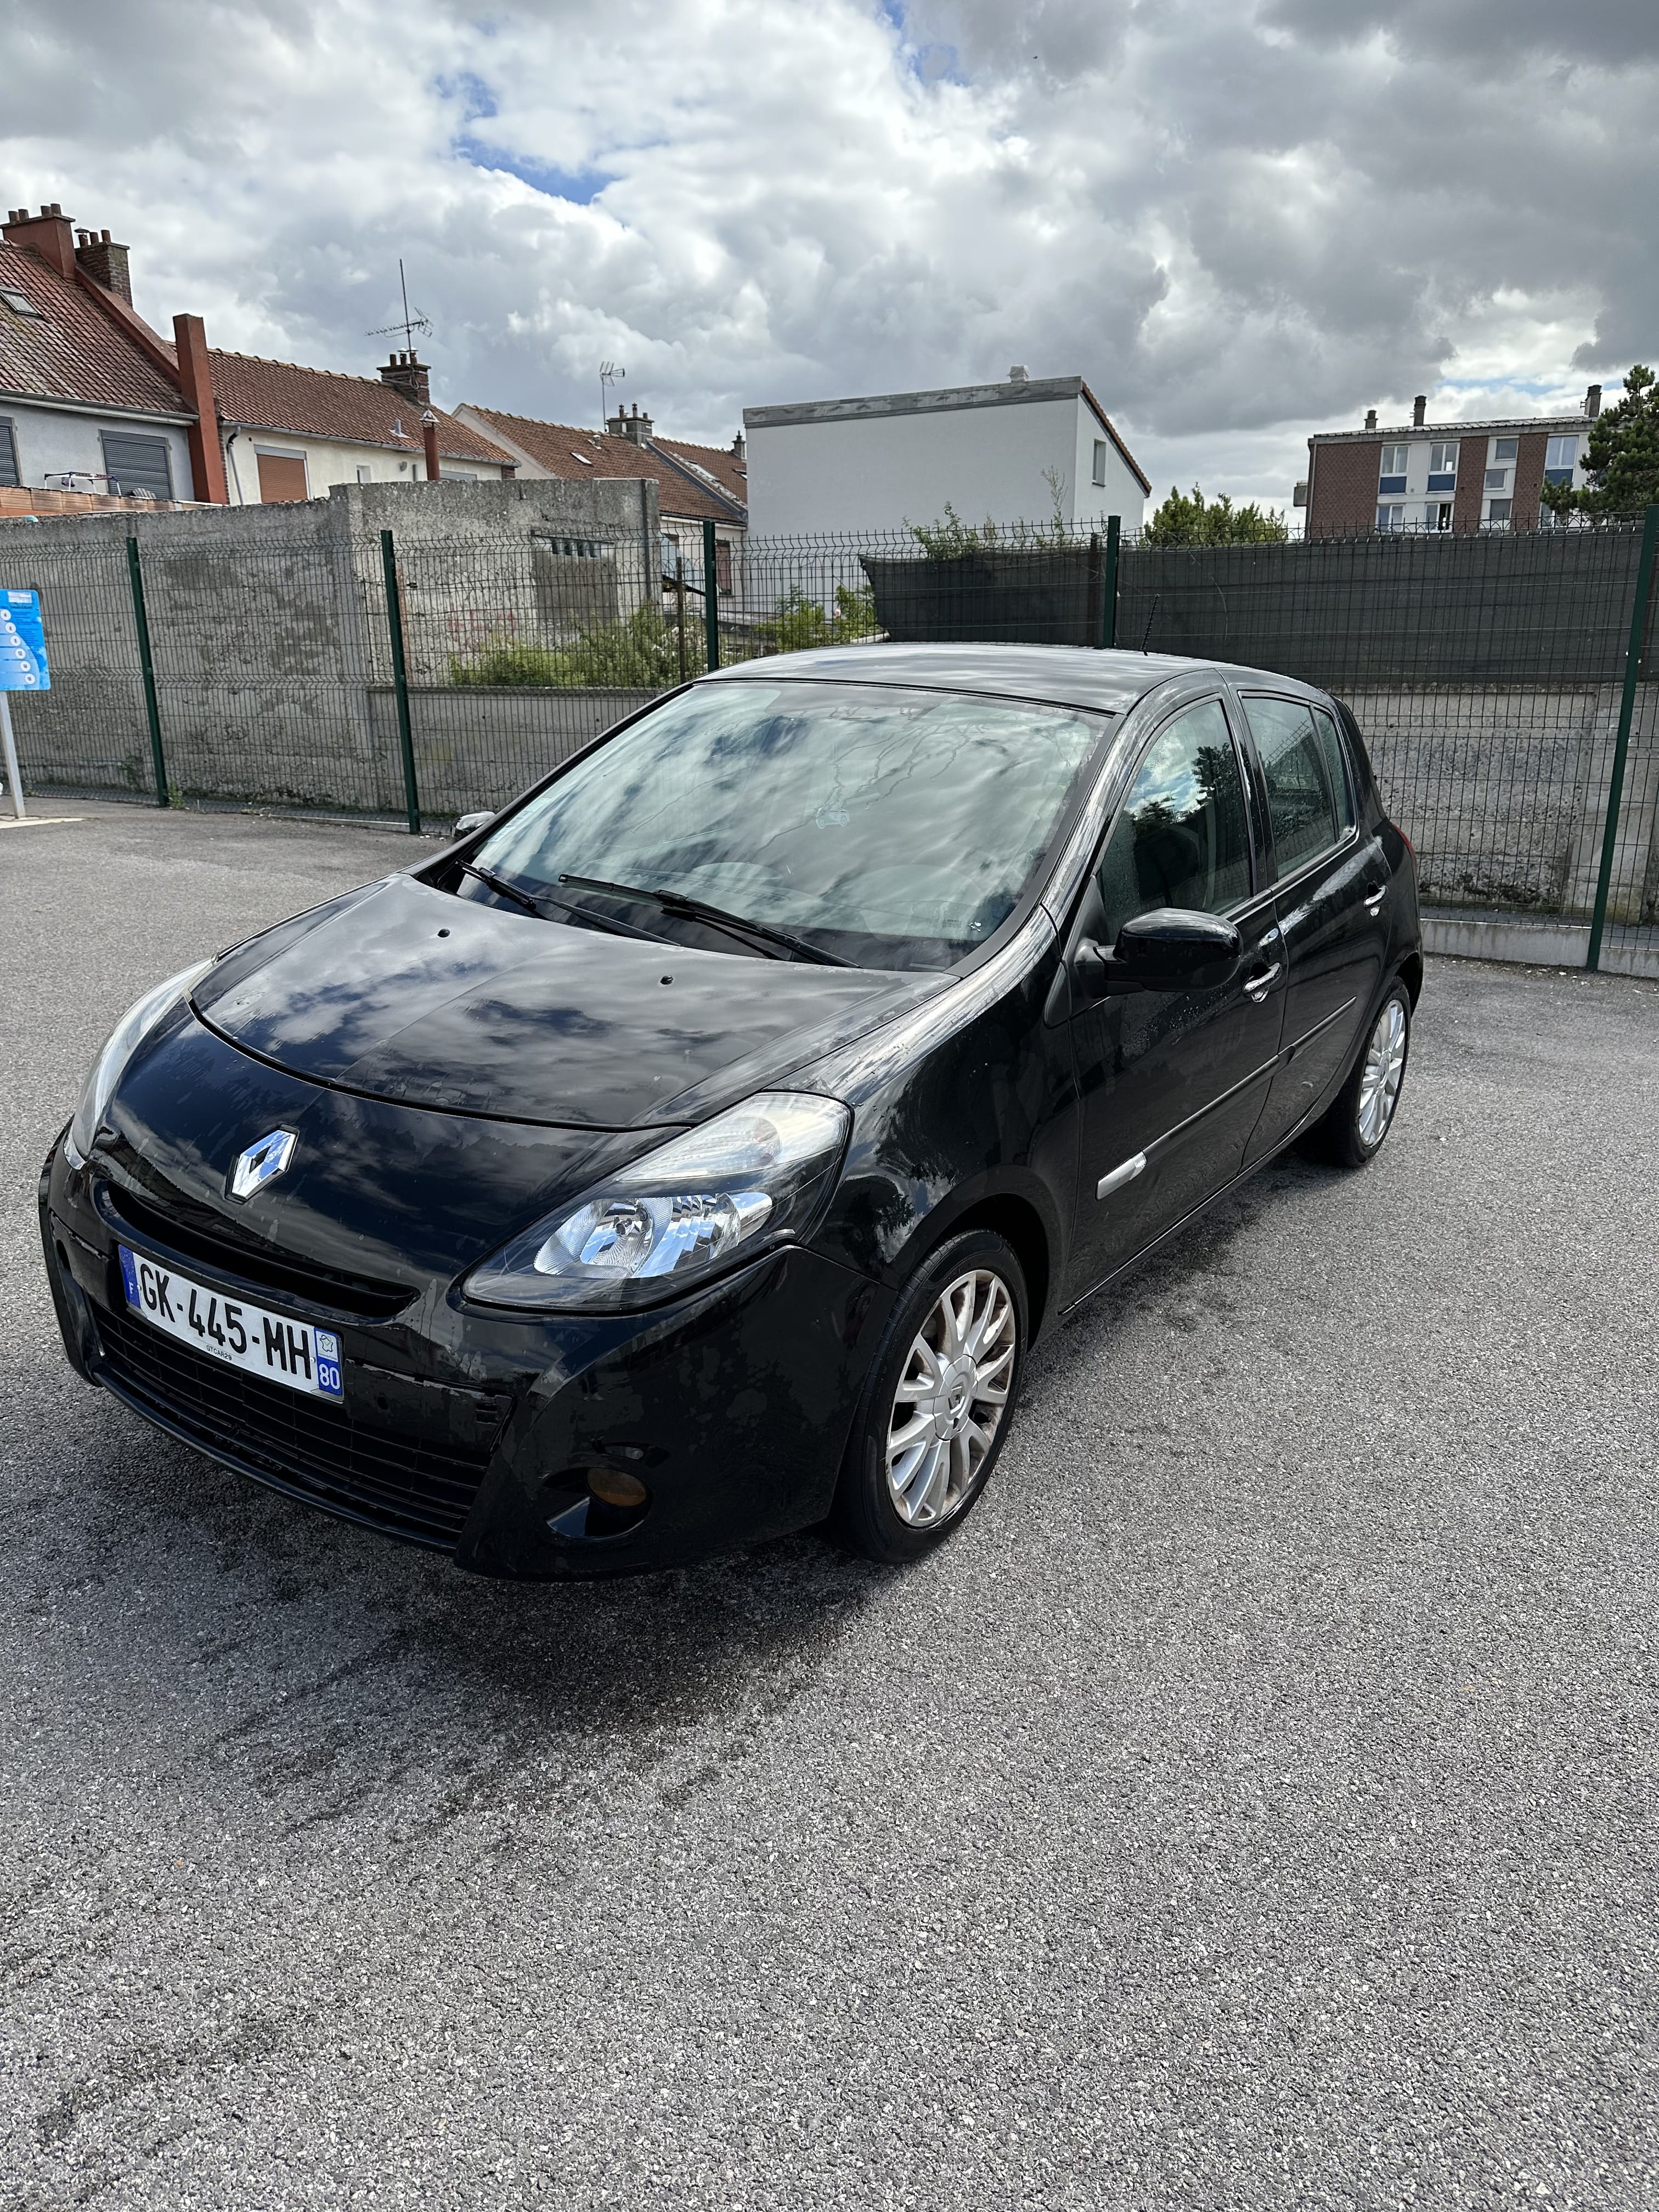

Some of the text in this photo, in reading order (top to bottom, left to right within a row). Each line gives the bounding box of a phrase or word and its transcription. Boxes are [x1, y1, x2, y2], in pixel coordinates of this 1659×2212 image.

[128, 1281, 133, 1294] F
[140, 1263, 312, 1380] GK-445-MH
[206, 1345, 232, 1361] GTCAR29
[319, 1363, 340, 1390] 80
